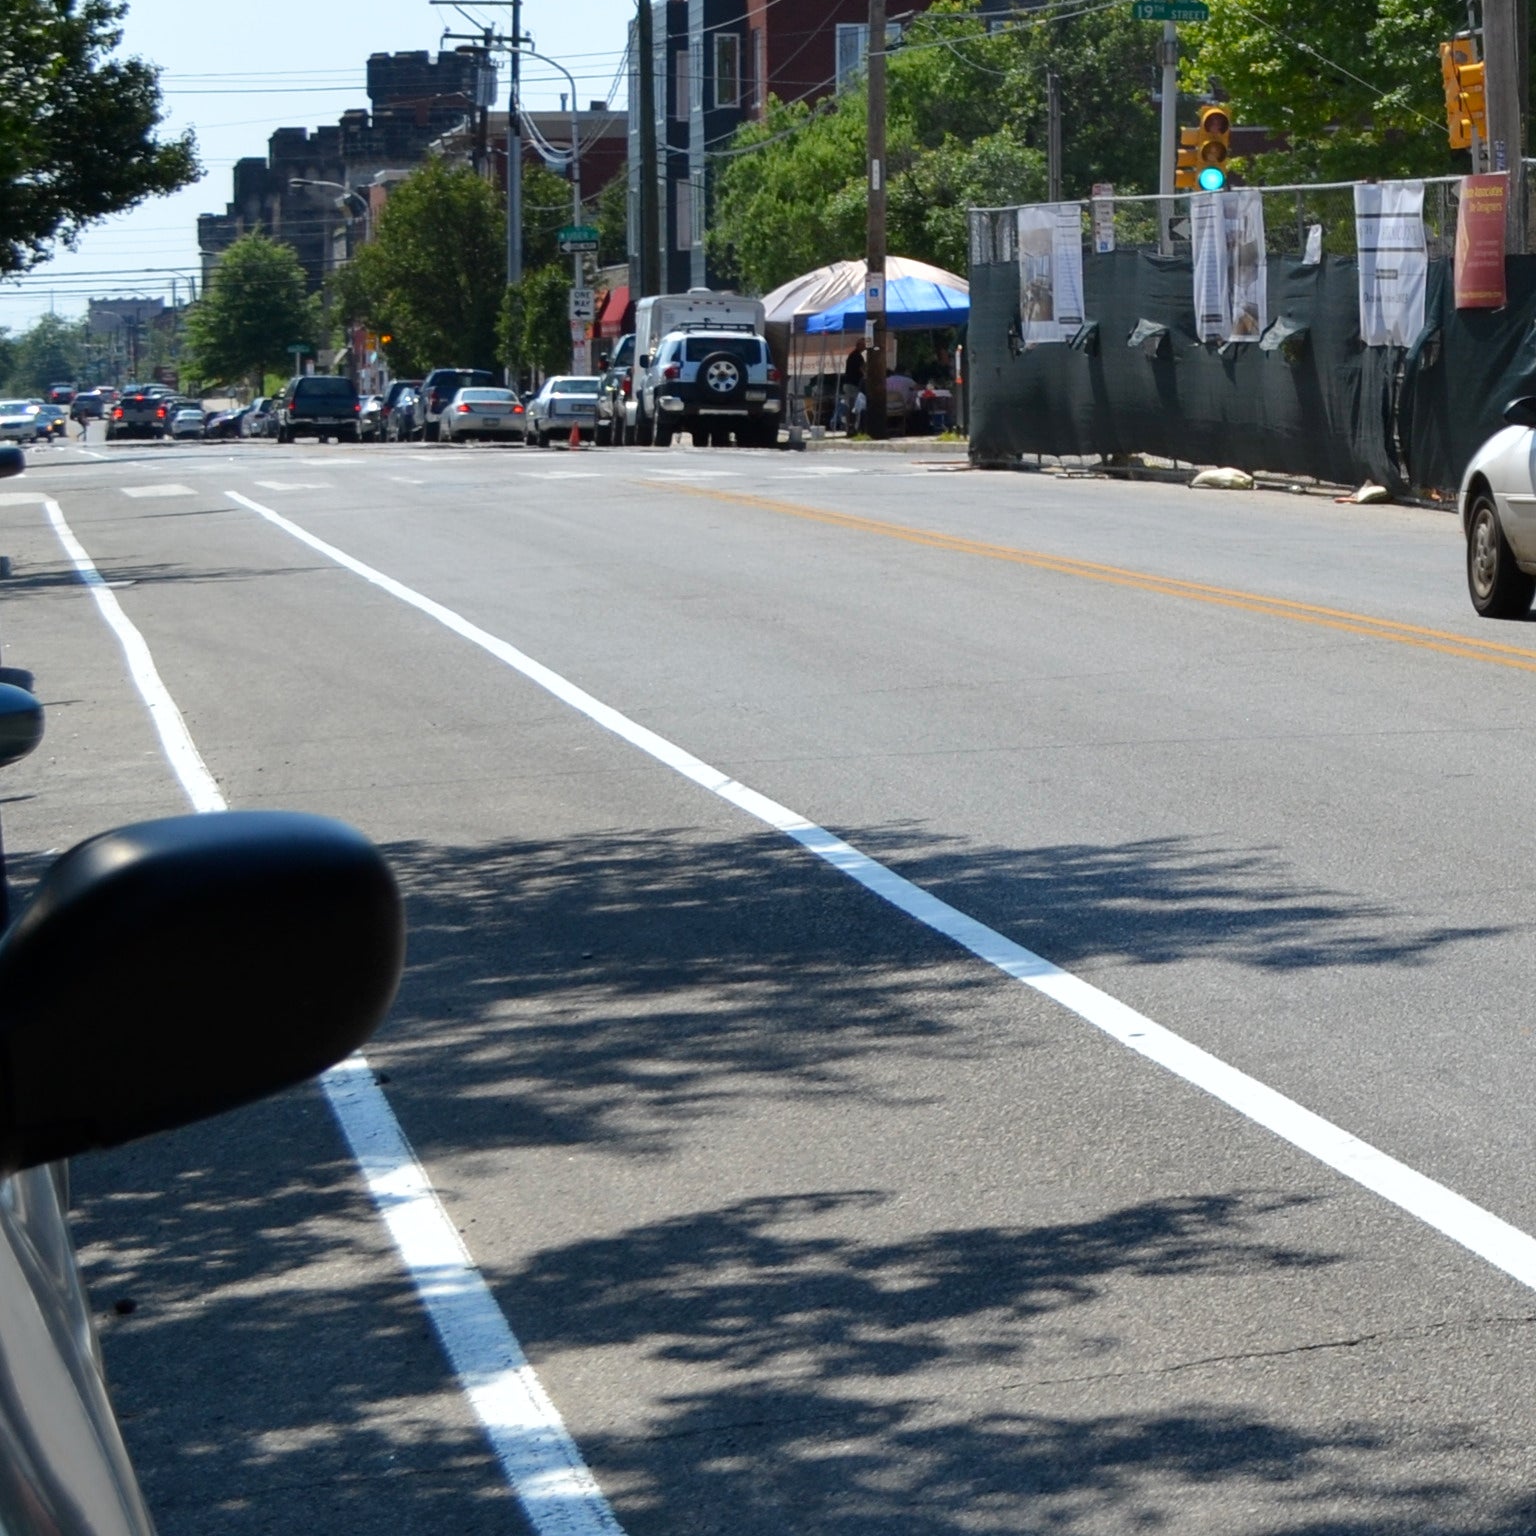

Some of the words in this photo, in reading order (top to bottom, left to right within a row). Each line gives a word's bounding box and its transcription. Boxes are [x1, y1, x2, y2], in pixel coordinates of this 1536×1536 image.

[1137, 5, 1166, 19] 19TH
[1171, 9, 1207, 20] STREET
[574, 291, 591, 300] ONE
[574, 300, 591, 308] WAY
